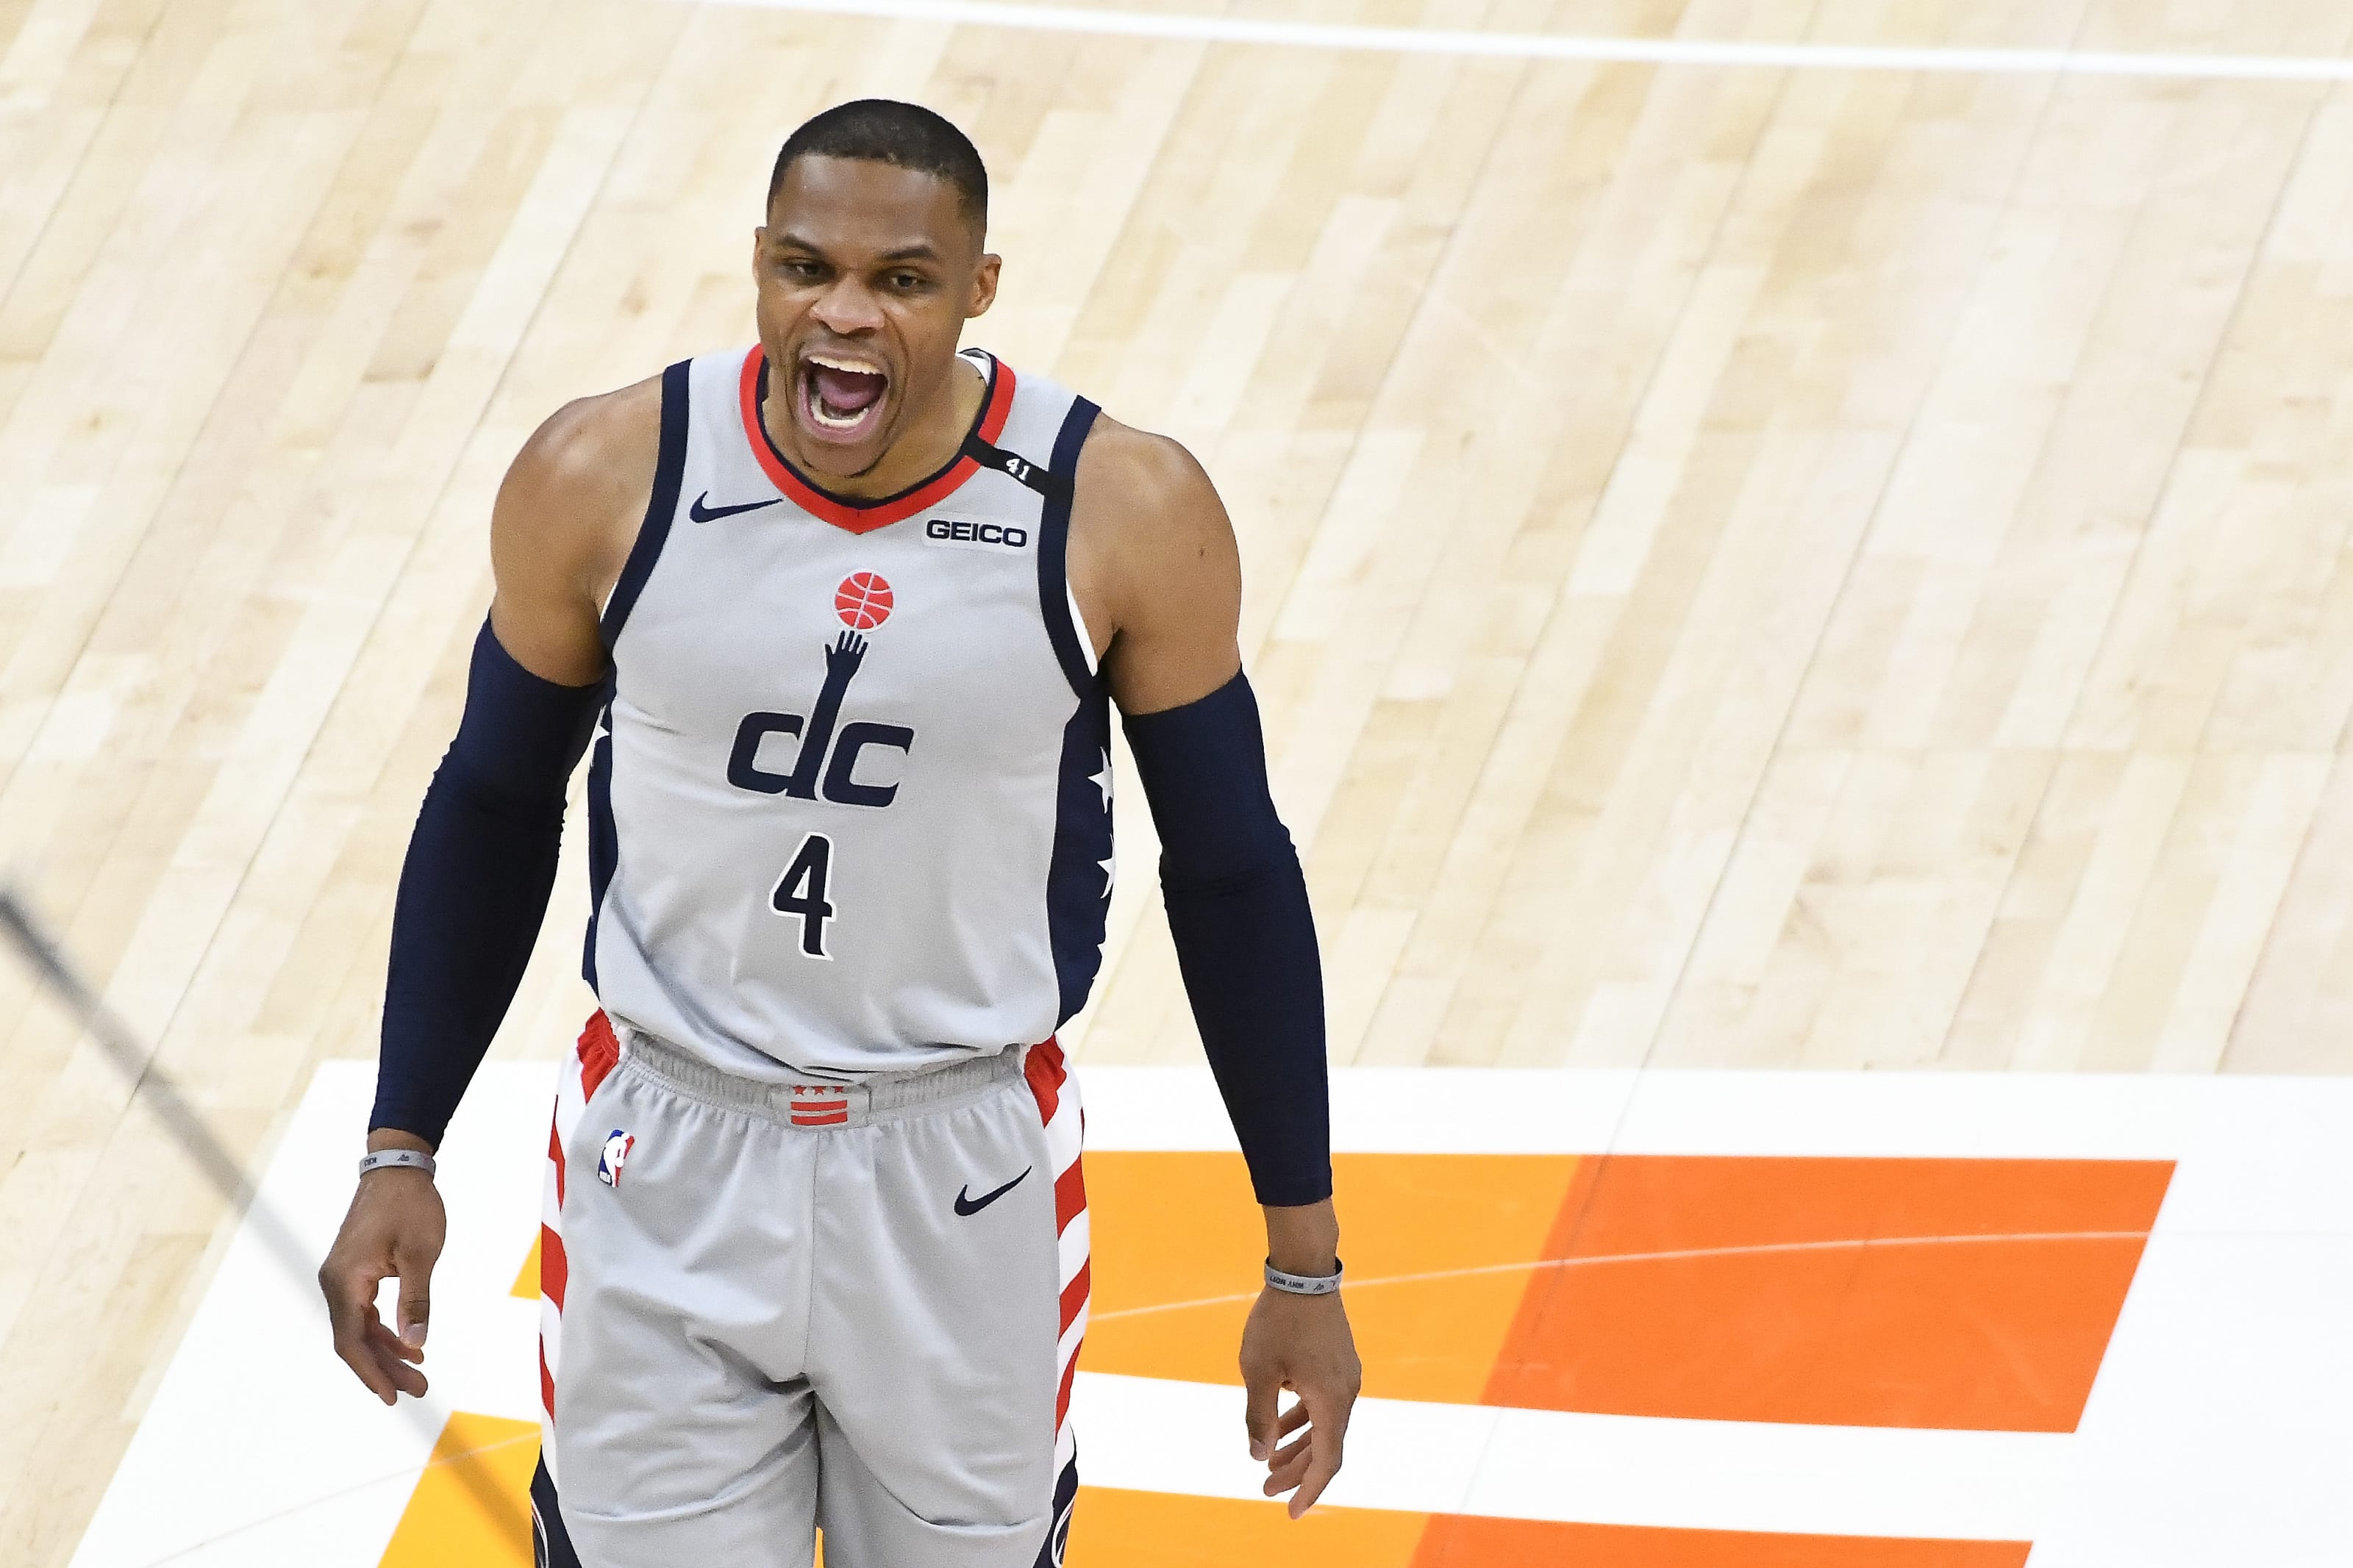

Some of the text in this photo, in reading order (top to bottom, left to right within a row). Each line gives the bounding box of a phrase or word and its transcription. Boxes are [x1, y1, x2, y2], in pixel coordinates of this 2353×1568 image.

[1006, 458, 1029, 481] 41
[926, 519, 1027, 547] GEICO
[769, 831, 837, 962] 4
